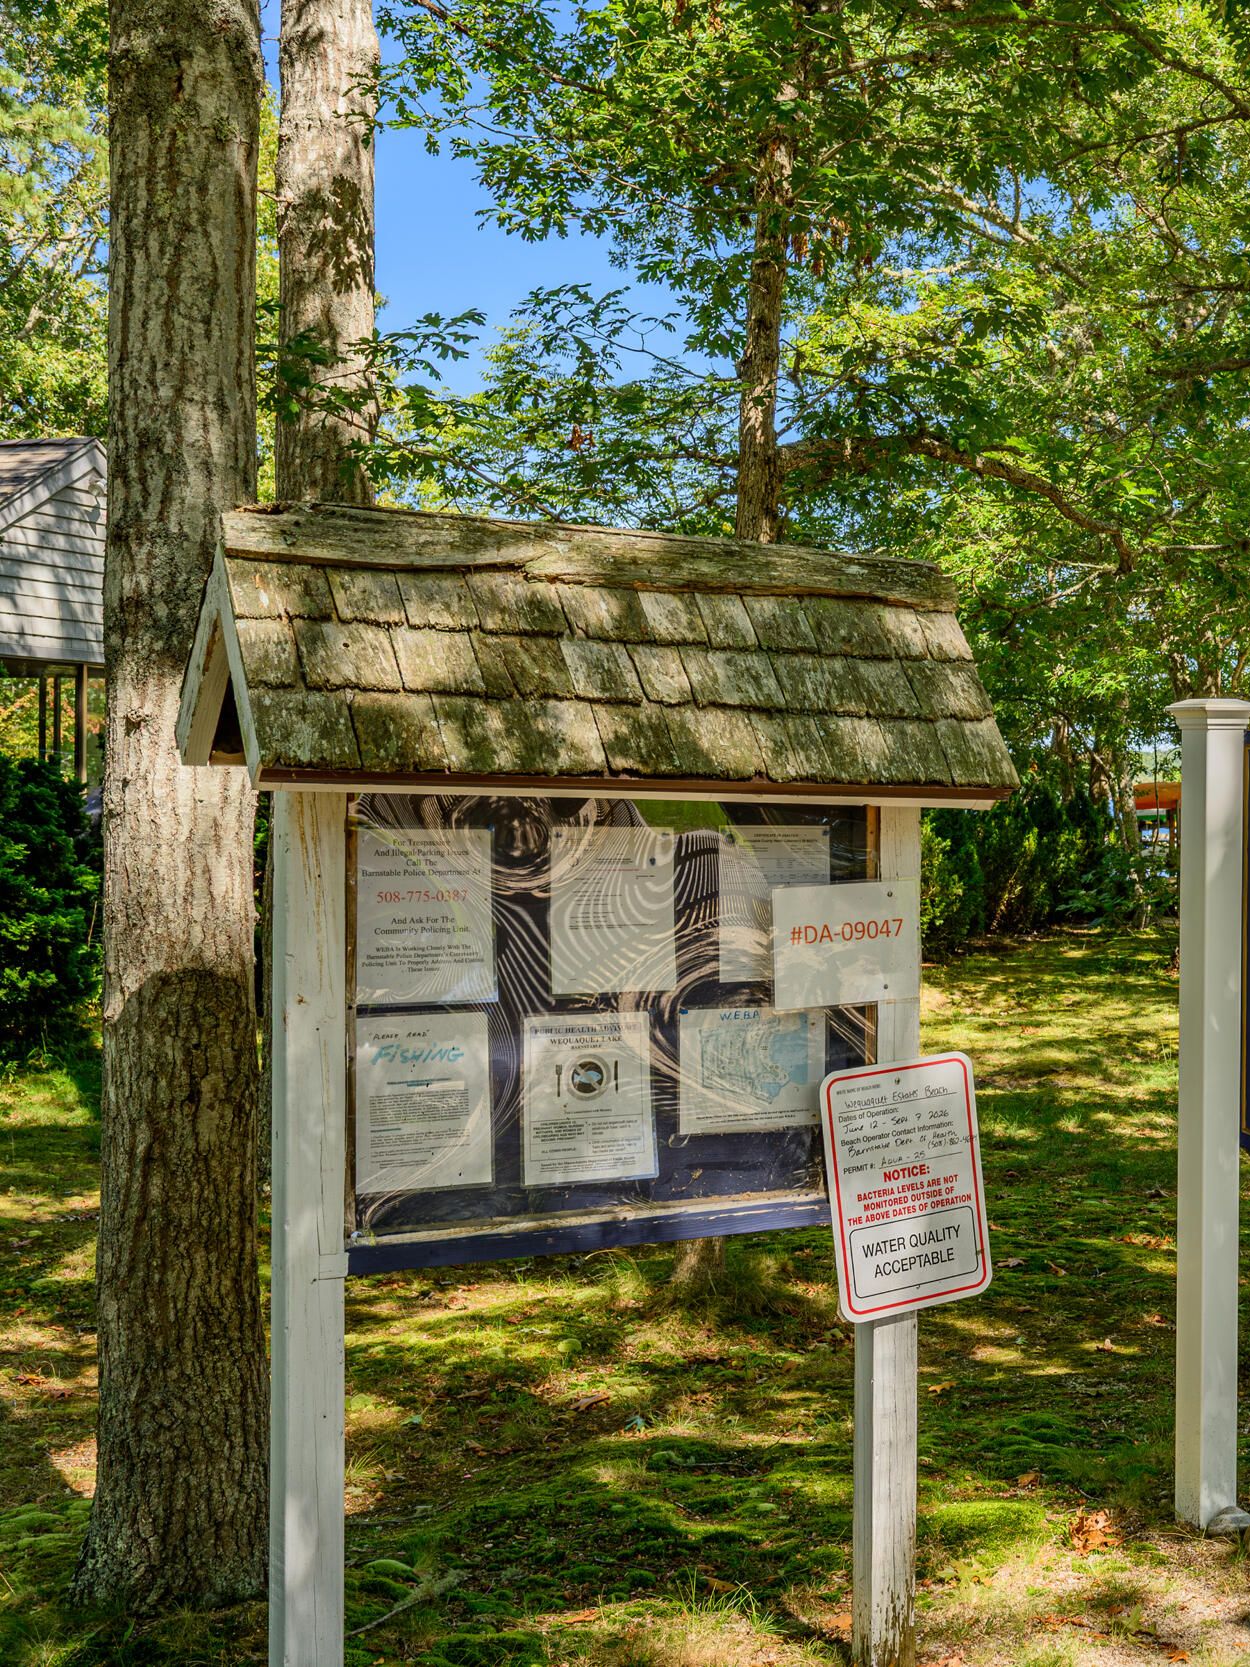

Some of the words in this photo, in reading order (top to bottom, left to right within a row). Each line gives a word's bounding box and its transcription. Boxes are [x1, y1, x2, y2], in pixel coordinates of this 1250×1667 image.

[374, 849, 389, 857] And
[418, 848, 445, 858] Parking
[403, 868, 426, 876] Police
[391, 917, 407, 925] And
[409, 916, 425, 924] Ask
[420, 926, 451, 935] Policing
[790, 919, 903, 946] #DA-09047
[924, 1085, 948, 1098] Beach
[838, 1114, 857, 1123] Dates
[858, 1112, 866, 1120] of
[866, 1107, 899, 1119] Operation:
[840, 1137, 865, 1147] Beach
[865, 1132, 891, 1143] Operator
[891, 1127, 916, 1137] Contact
[917, 1120, 954, 1133] Information:
[842, 1123, 864, 1134] June
[869, 1120, 878, 1129] 12
[843, 1164, 868, 1175] PERMIT
[883, 1164, 930, 1183] NOTICE:
[857, 1187, 895, 1202] BACTERIA
[896, 1182, 925, 1194] LEVELS
[925, 1178, 941, 1189] ARE
[942, 1174, 959, 1184] NOT
[863, 1196, 909, 1212] MONITORED
[910, 1190, 943, 1203] OUTSIDE
[944, 1186, 955, 1196] OF
[847, 1218, 863, 1227] THE
[865, 1211, 890, 1224] ABOVE
[892, 1205, 916, 1218] DATES
[918, 1203, 929, 1212] OF
[930, 1193, 972, 1210] OPERATION
[862, 1235, 906, 1258] WATER
[909, 1224, 961, 1248] QUALITY
[874, 1248, 955, 1278] ACCEPTABLE
